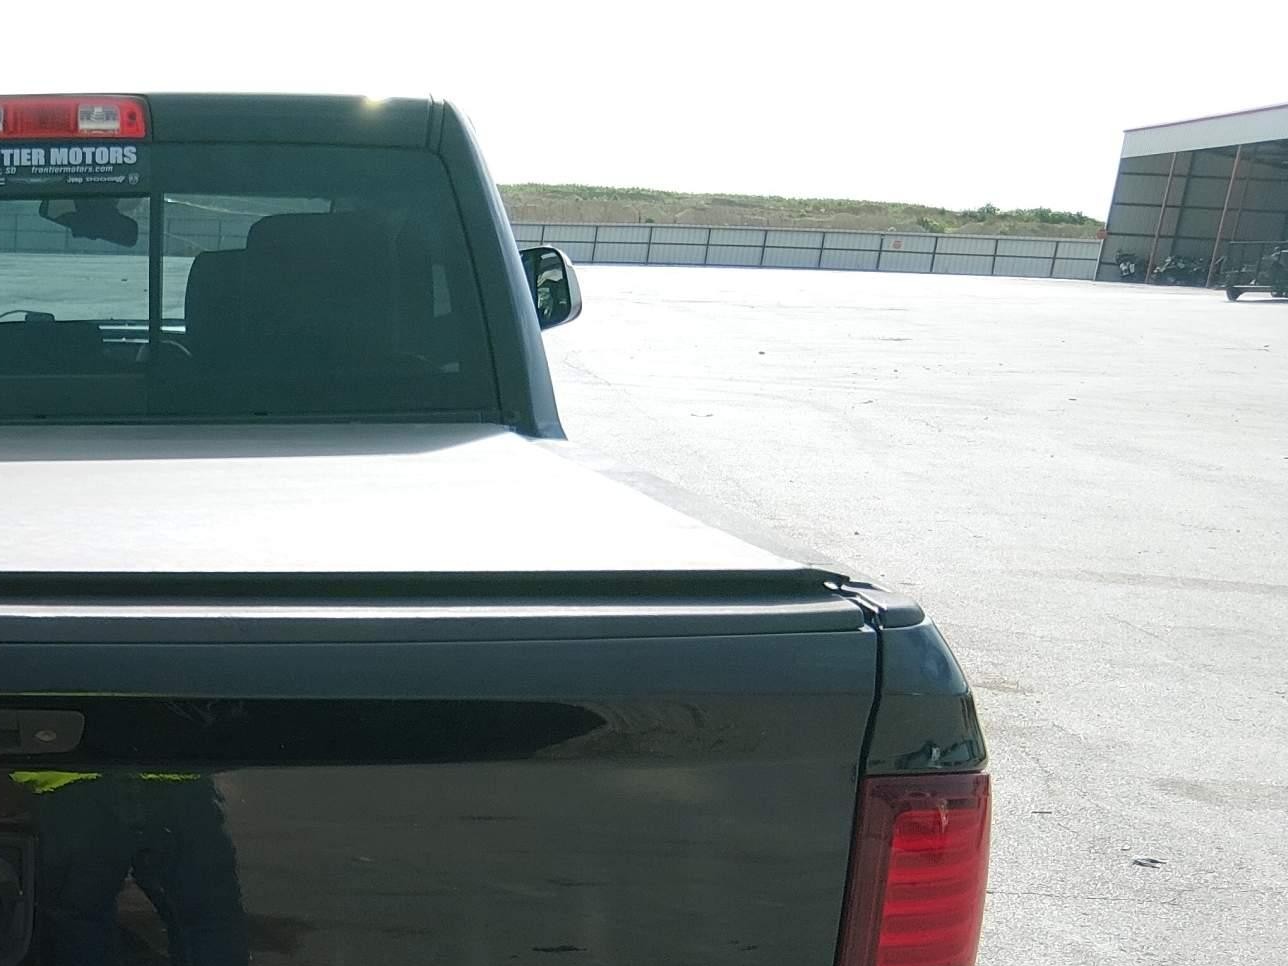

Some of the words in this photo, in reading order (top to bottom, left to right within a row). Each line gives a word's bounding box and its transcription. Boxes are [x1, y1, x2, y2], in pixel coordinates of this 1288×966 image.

[50, 146, 137, 165] MOTORS
[5, 166, 17, 175] SD
[31, 165, 114, 174] frontiermotors.com
